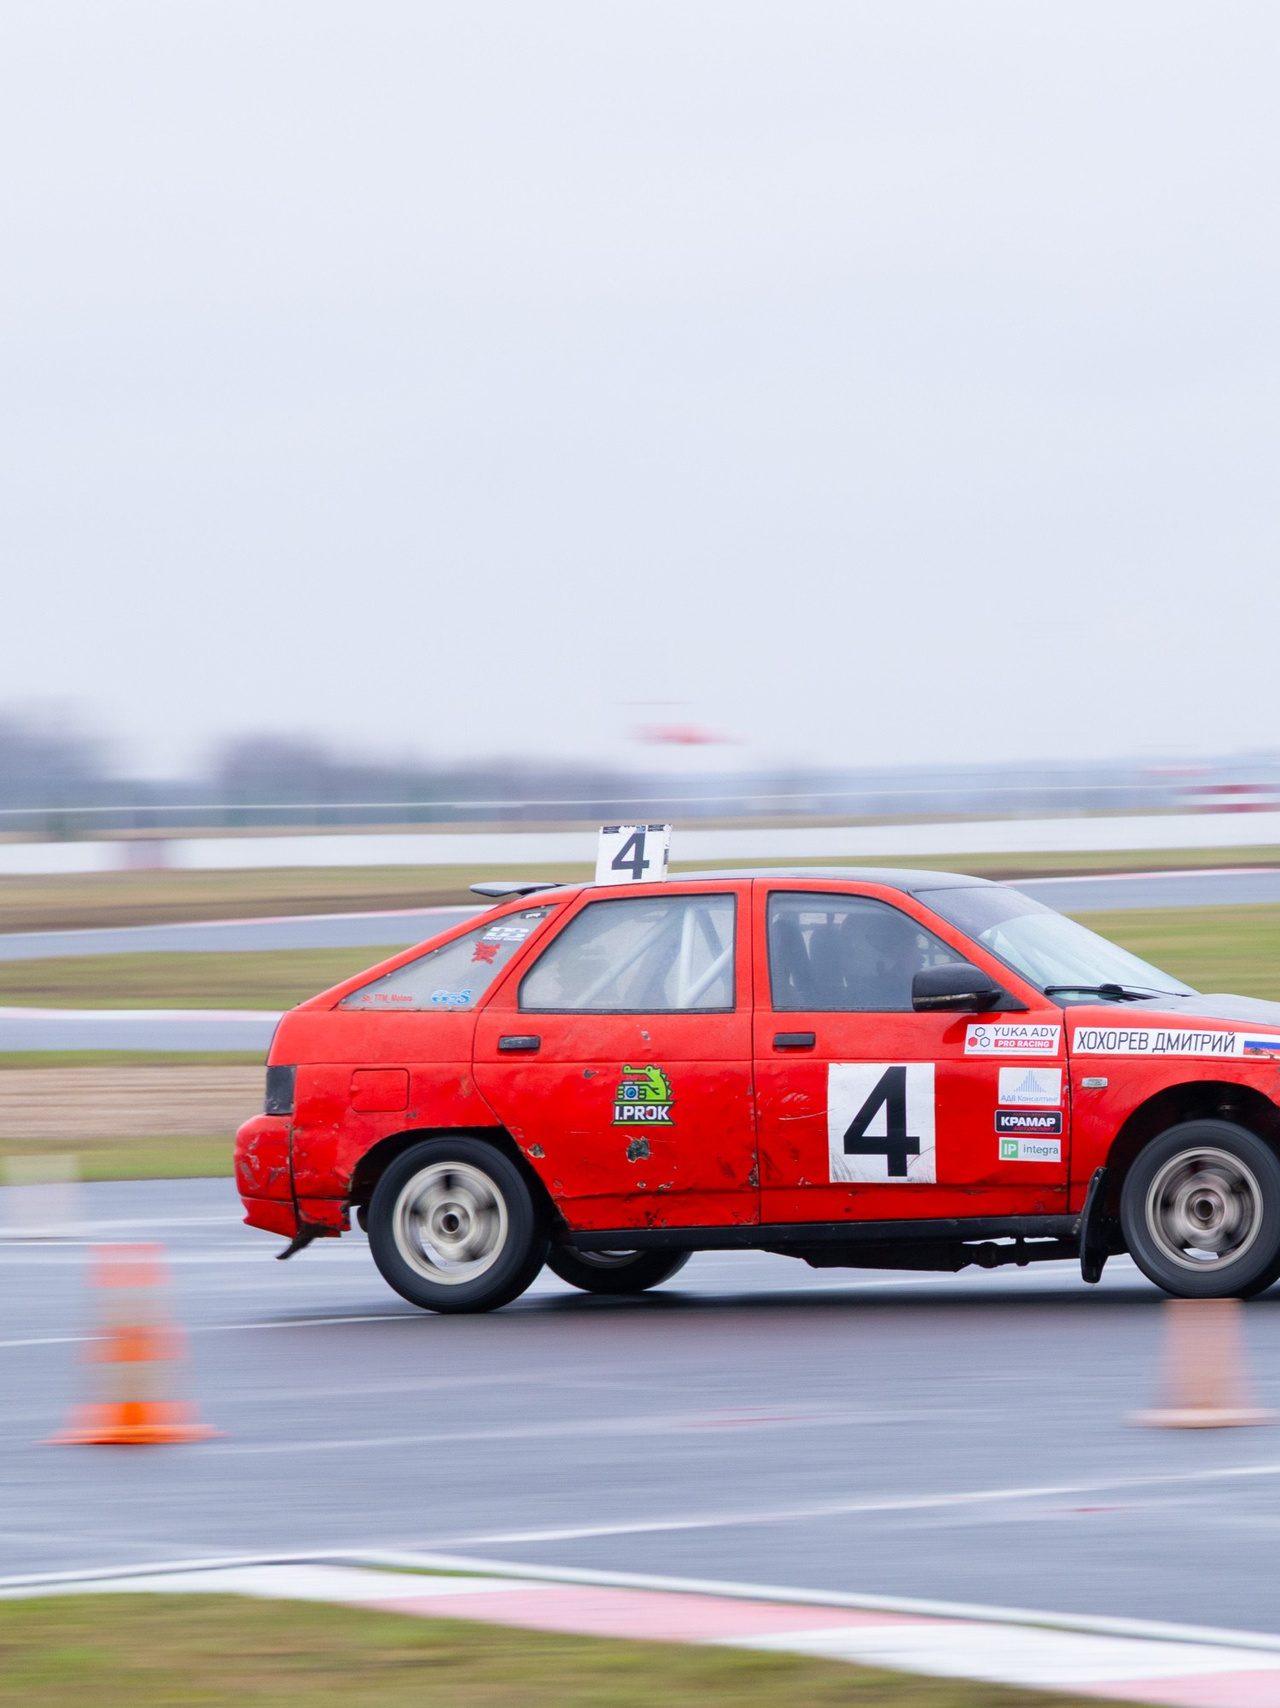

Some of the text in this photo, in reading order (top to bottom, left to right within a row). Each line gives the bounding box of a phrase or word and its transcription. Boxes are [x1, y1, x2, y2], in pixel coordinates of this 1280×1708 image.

[611, 826, 650, 879] 4
[994, 1027, 1058, 1037] YUKA ADV
[1017, 1040, 1050, 1048] RACING
[1077, 1031, 1236, 1053] ХОХОРЕВ ДМИТРИЙ
[615, 1105, 670, 1120] I.PROK
[843, 1066, 920, 1176] 4
[1001, 1116, 1056, 1127] КРАМАР
[1004, 1143, 1059, 1156] IP integra
